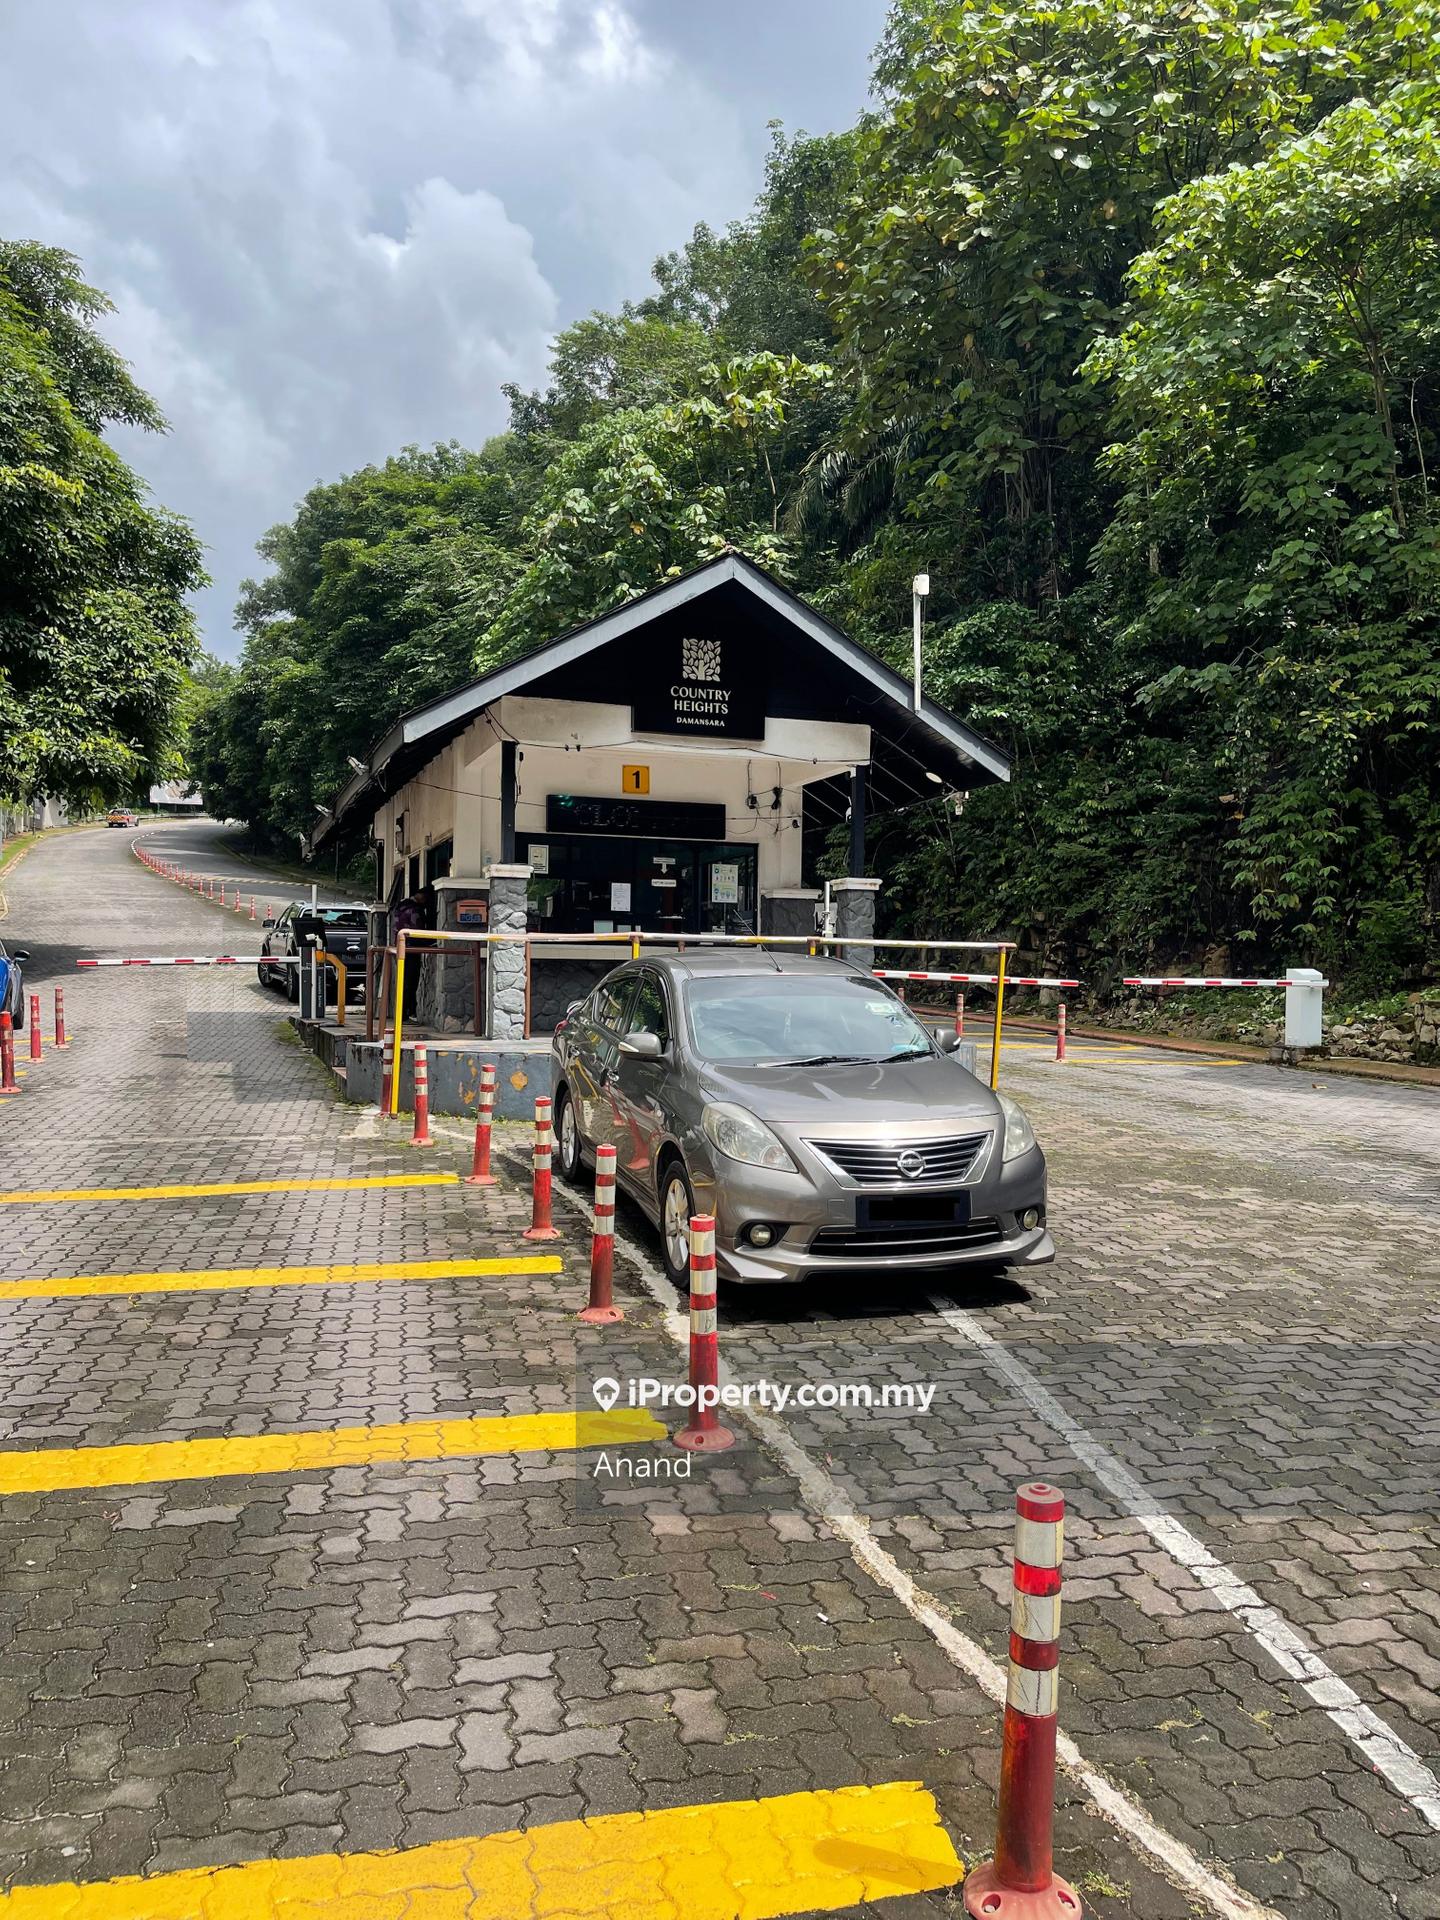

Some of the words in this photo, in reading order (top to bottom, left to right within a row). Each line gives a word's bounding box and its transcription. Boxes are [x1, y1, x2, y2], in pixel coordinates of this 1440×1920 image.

[670, 685, 732, 702] COUNTRY
[674, 699, 729, 715] HEIGHTS
[676, 716, 726, 727] DAMANSARA
[632, 770, 640, 789] 1
